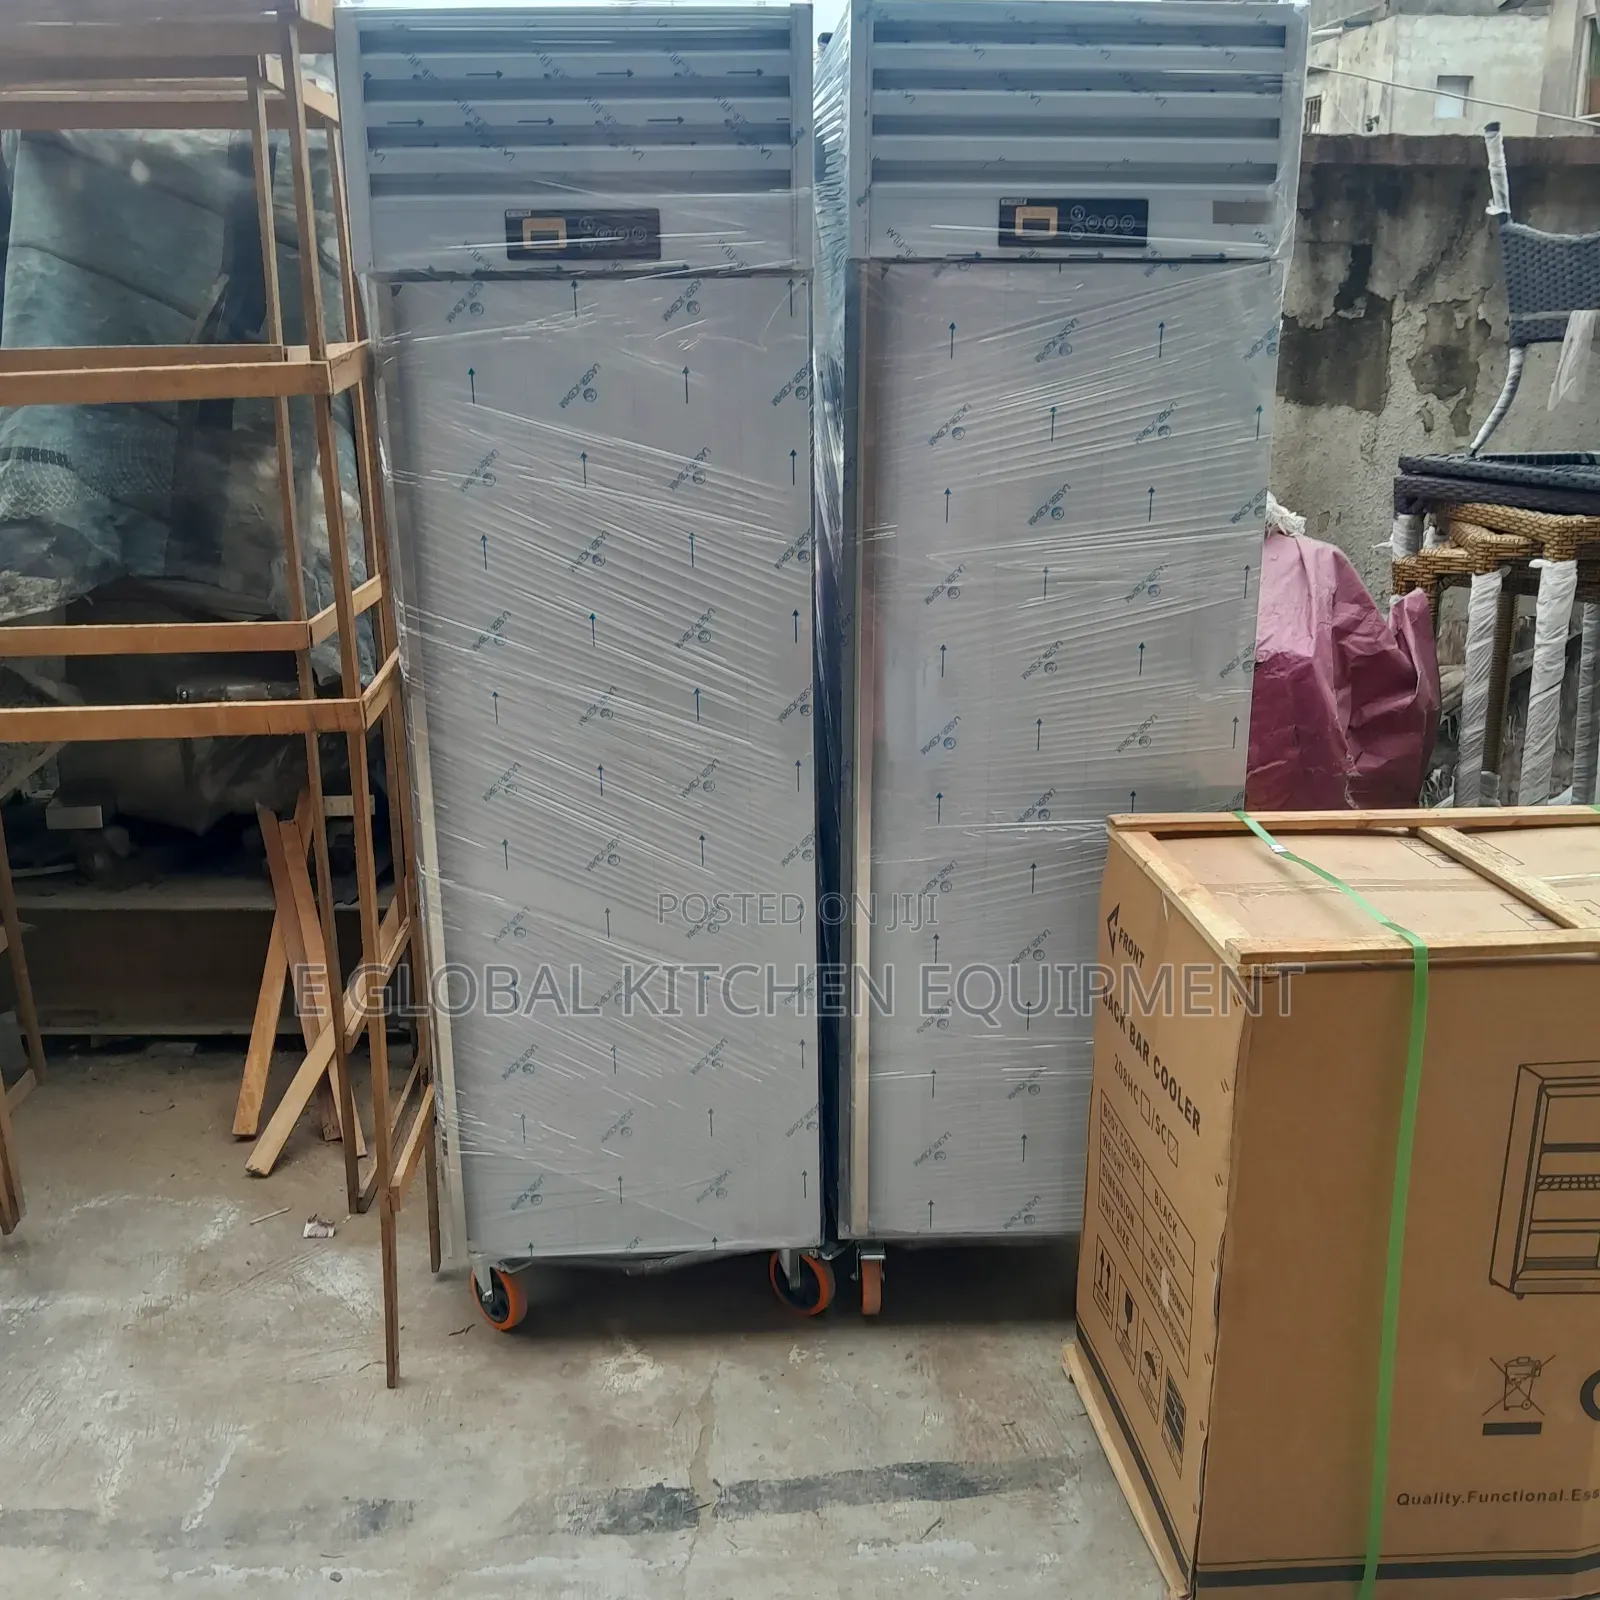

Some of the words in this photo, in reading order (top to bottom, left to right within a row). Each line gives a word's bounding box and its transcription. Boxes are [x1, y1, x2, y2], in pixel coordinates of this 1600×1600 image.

[1117, 926, 1146, 969] FRONT
[1102, 986, 1127, 1036] BACK
[1128, 1019, 1151, 1068] BAR
[1152, 1054, 1201, 1138] COOLER
[1113, 1053, 1139, 1106] 208HC
[1119, 1131, 1142, 1175] COLOR
[1101, 1162, 1136, 1229] DIMENSION
[1101, 1191, 1117, 1224] UNIT
[1116, 1218, 1132, 1253] SIZE
[1154, 1187, 1179, 1239] BLACK
